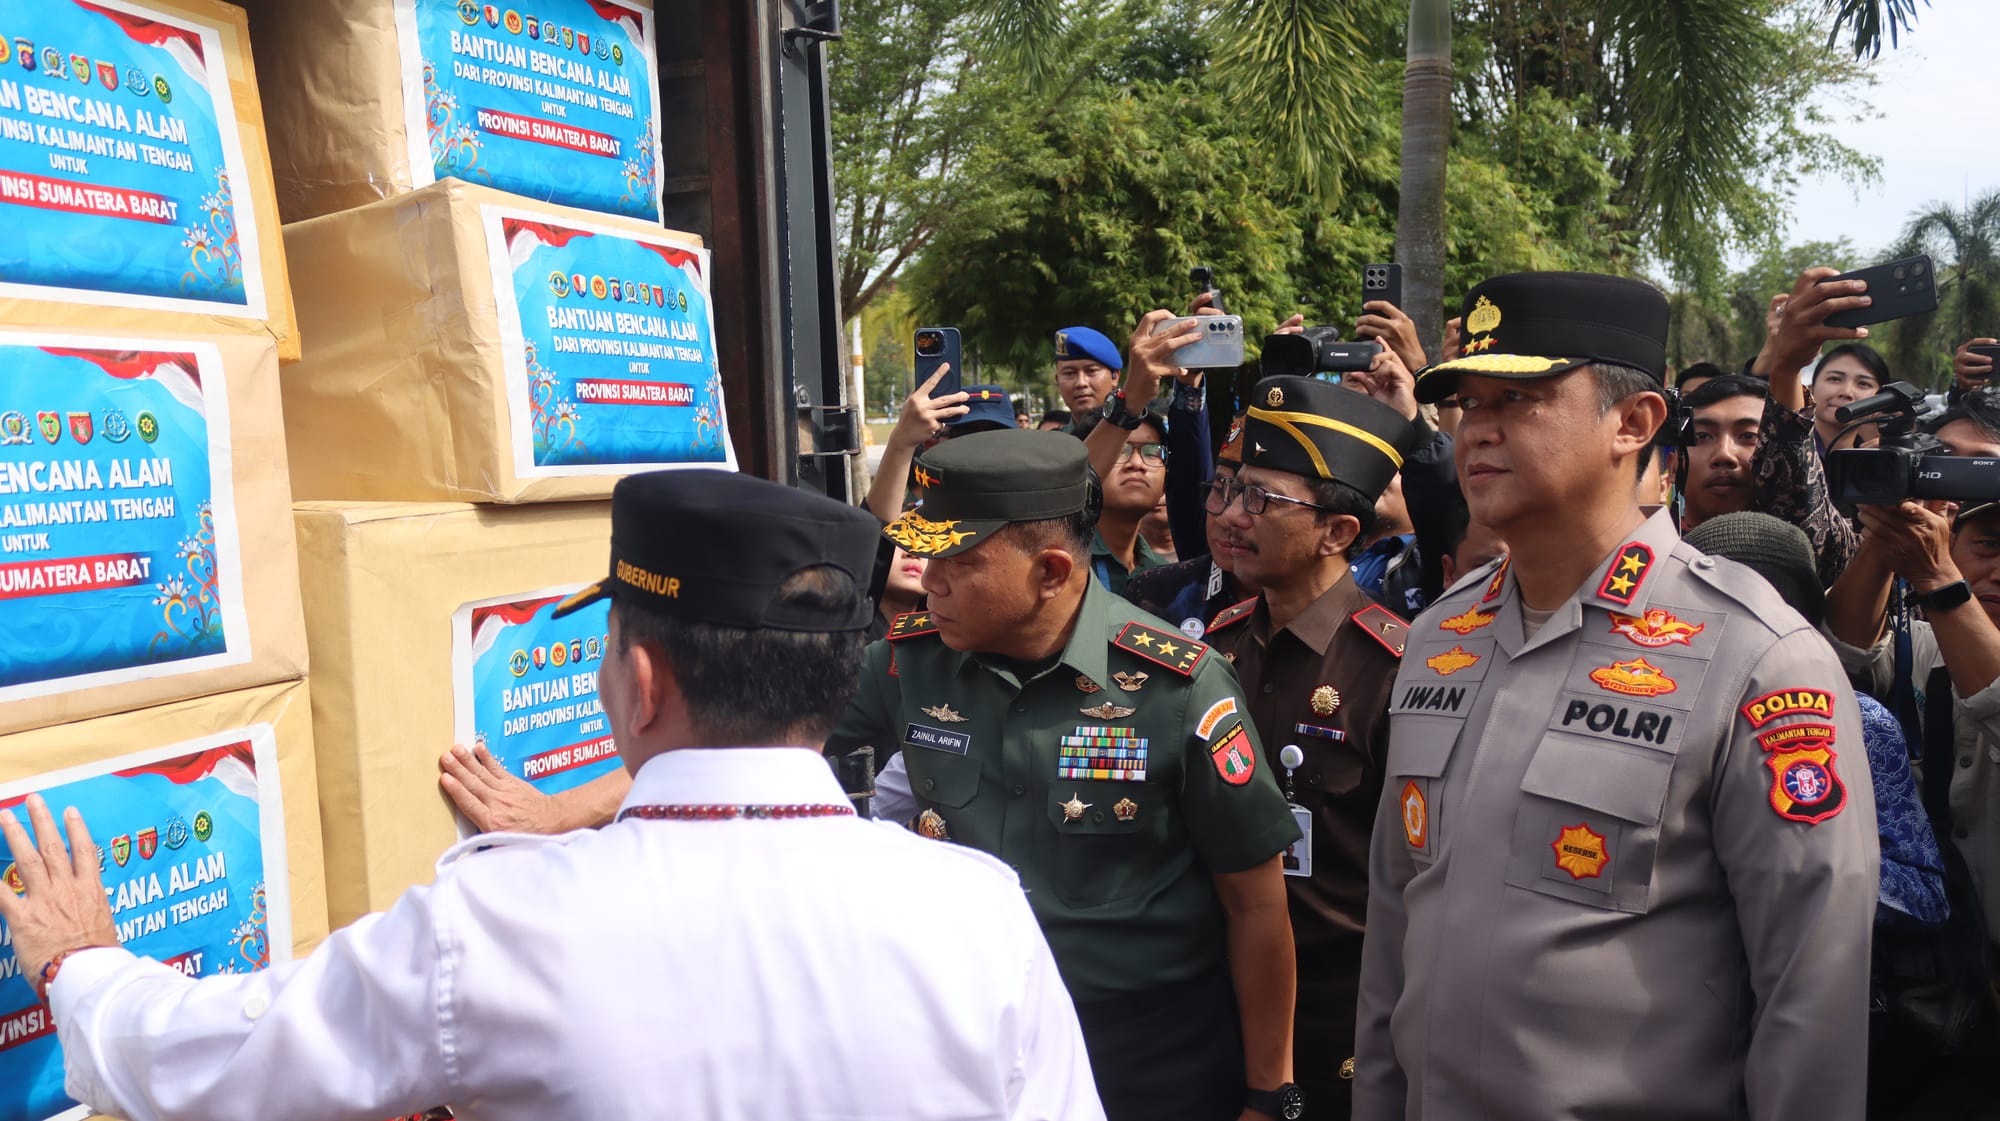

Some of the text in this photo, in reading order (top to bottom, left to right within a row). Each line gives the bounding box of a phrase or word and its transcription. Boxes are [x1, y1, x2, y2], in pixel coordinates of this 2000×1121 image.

[450, 30, 631, 98] BANTUAN BENCANA ALAM
[454, 61, 633, 119] DARI PROVINSI KALIMANTAN TENGAH
[24, 84, 132, 133] BENCANA
[136, 109, 188, 145] ALAM
[541, 102, 567, 118] UNTUK
[36, 125, 138, 162] KALIMANTAN
[139, 143, 194, 173] TENGAH
[477, 111, 621, 155] PROVINSI SUMATERA BARAT
[49, 153, 89, 175] UNTUK
[38, 182, 128, 212] SUMATERA
[129, 195, 178, 220] BARAT
[546, 306, 699, 342] BANTUAN BENCANA ALAM
[553, 336, 703, 363] DARI PROVINSI KALIMANTAN TENGAH
[629, 361, 650, 375] UNTUK
[576, 383, 694, 402] PROVINSI SUMATERA BARAT
[109, 457, 173, 488] ALAM
[1919, 471, 1942, 479] HD
[0, 496, 175, 528] ALIMANTAN TENGAH
[2, 533, 51, 553] UNTUK
[0, 557, 151, 592] UMATERA BARAT
[616, 559, 681, 599] GUBERNUR
[1178, 645, 1203, 669] TNI
[502, 677, 569, 713] BANTUAN
[1400, 686, 1466, 712] IWAN
[1750, 692, 1828, 721] POLDA
[503, 715, 529, 737] DARI
[530, 705, 575, 731] PROVINSI
[580, 719, 604, 735] UNTUK
[1562, 699, 1672, 745] POLRI
[1765, 728, 1831, 745] KALIMANTAN TENGAH
[911, 730, 962, 748] ZAINUL ARIFIN
[523, 739, 617, 777] PROVINSI SUMATER
[1563, 844, 1598, 860] RESERSE
[168, 851, 227, 896] ALAM
[171, 888, 228, 924] TENGAH
